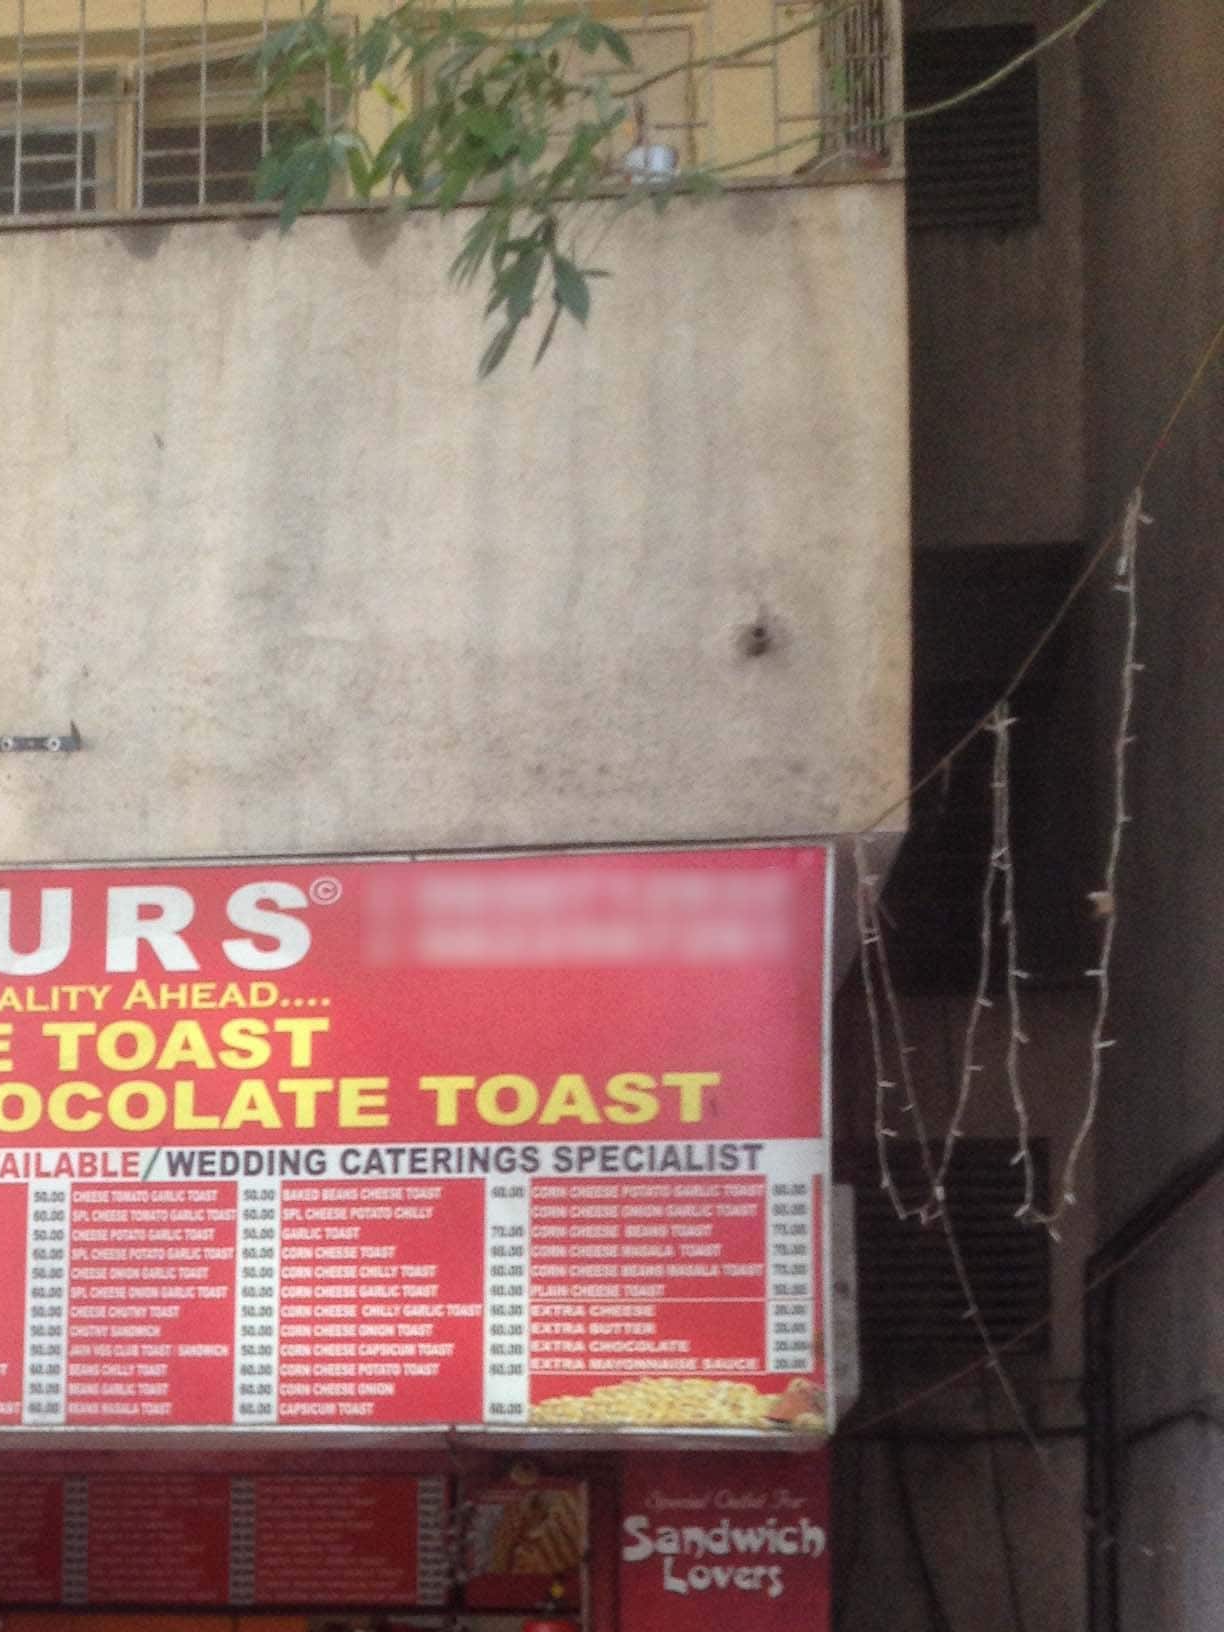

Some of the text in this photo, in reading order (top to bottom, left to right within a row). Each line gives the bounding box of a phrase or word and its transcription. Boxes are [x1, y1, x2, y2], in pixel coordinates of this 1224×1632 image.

[42, 1016, 330, 1071] TOAST
[420, 1072, 720, 1127] TOAST
[167, 1149, 327, 1178] WEDDING
[339, 1147, 540, 1176] CATERINGS
[554, 1143, 764, 1173] SPECIALIST
[622, 1514, 826, 1562] Sandwich
[663, 1556, 784, 1598] Lovers
